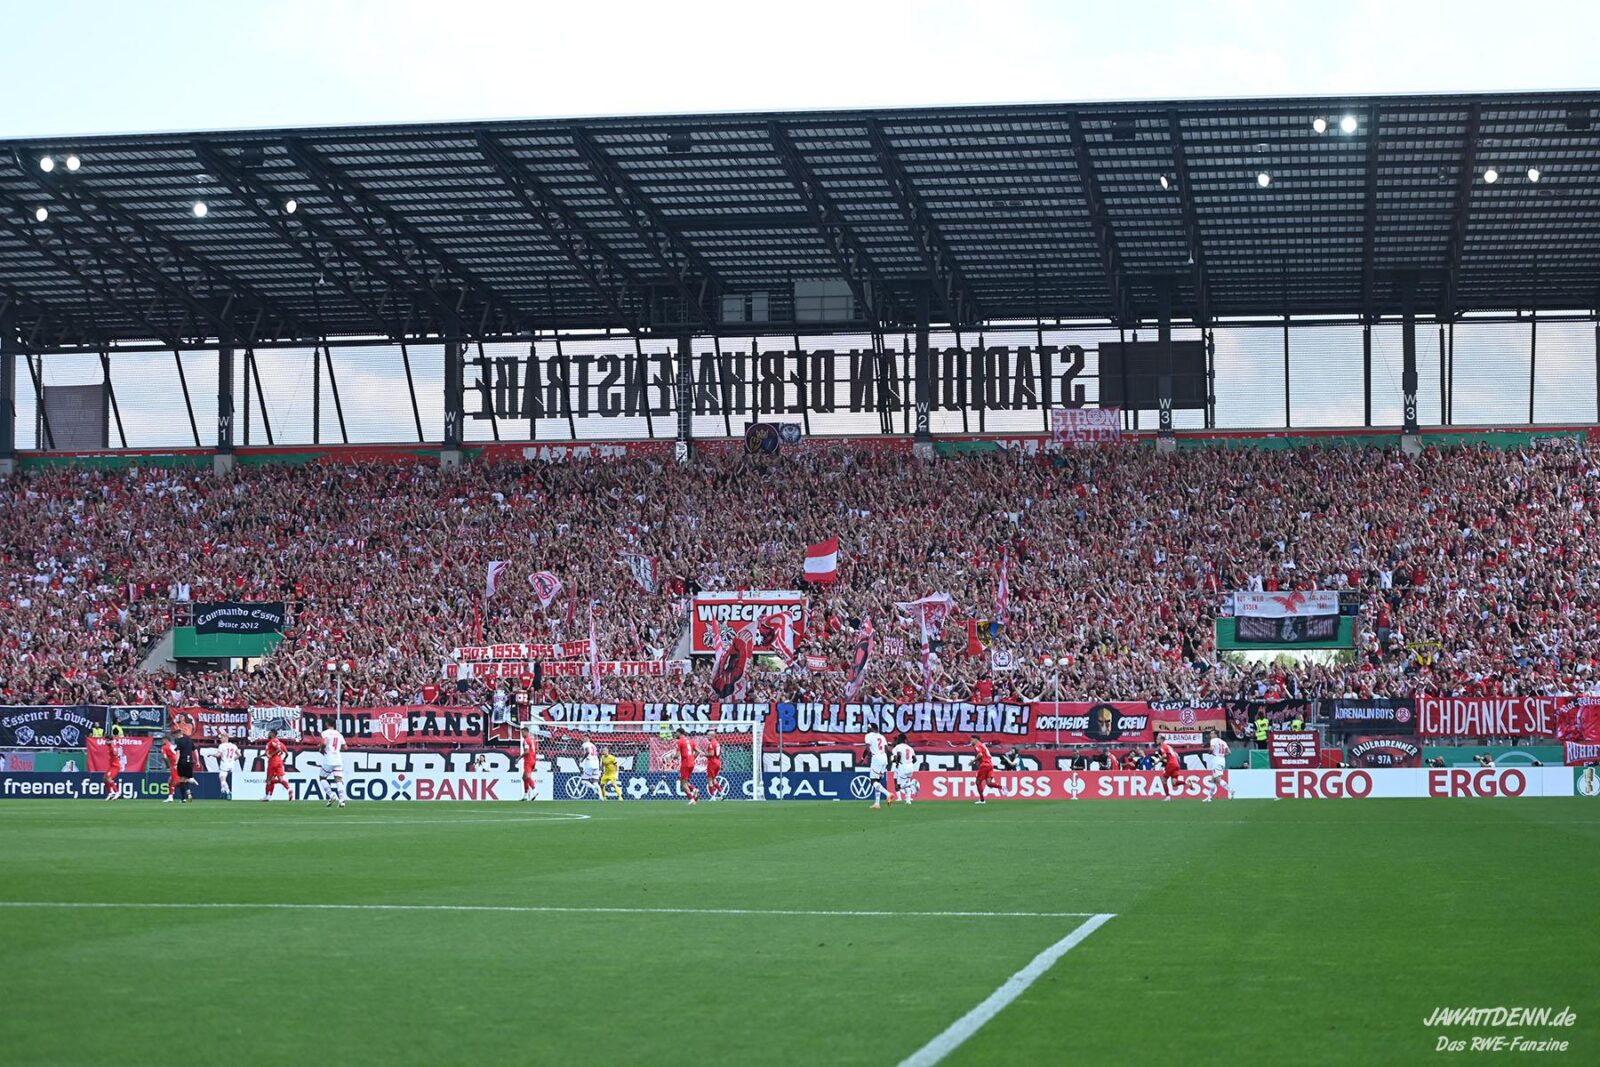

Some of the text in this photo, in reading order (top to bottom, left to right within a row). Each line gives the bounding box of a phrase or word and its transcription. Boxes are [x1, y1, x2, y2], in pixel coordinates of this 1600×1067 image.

[917, 402, 928, 428] W 2
[1159, 399, 1171, 424] W 3
[1404, 394, 1416, 420] W 3
[218, 416, 229, 440] W 1
[445, 411, 456, 436] W 1
[1053, 425, 1120, 442] KASTEN
[197, 607, 280, 625] Commando Essen
[697, 603, 802, 622] WRECKING
[217, 619, 239, 628] Since
[491, 645, 521, 658] 1953
[540, 662, 585, 676] ÄCHST
[2, 709, 50, 729] Essener
[54, 707, 94, 730] Löwen
[643, 702, 711, 734] HASS
[719, 702, 770, 734] AUF
[776, 702, 1030, 735] BULLENSCHWEINE!
[1335, 704, 1395, 720] ADRENALIN BOYS
[1419, 696, 1554, 735] ICH DANKE SIE
[203, 725, 247, 738] ESSEN
[303, 711, 373, 739] RDE
[407, 710, 483, 737] FANS
[1117, 715, 1149, 730] CREW
[34, 735, 62, 746] 1980
[97, 738, 143, 746] Urt-Ultras
[876, 737, 883, 751] 2
[1352, 739, 1419, 758] DAUERBRENNER
[1377, 754, 1392, 765] 97A
[3, 777, 170, 799] freenet, ferig, los
[932, 775, 1218, 798] STRAUSS STRAUSS
[1275, 769, 1527, 799] ERGO ERGO
